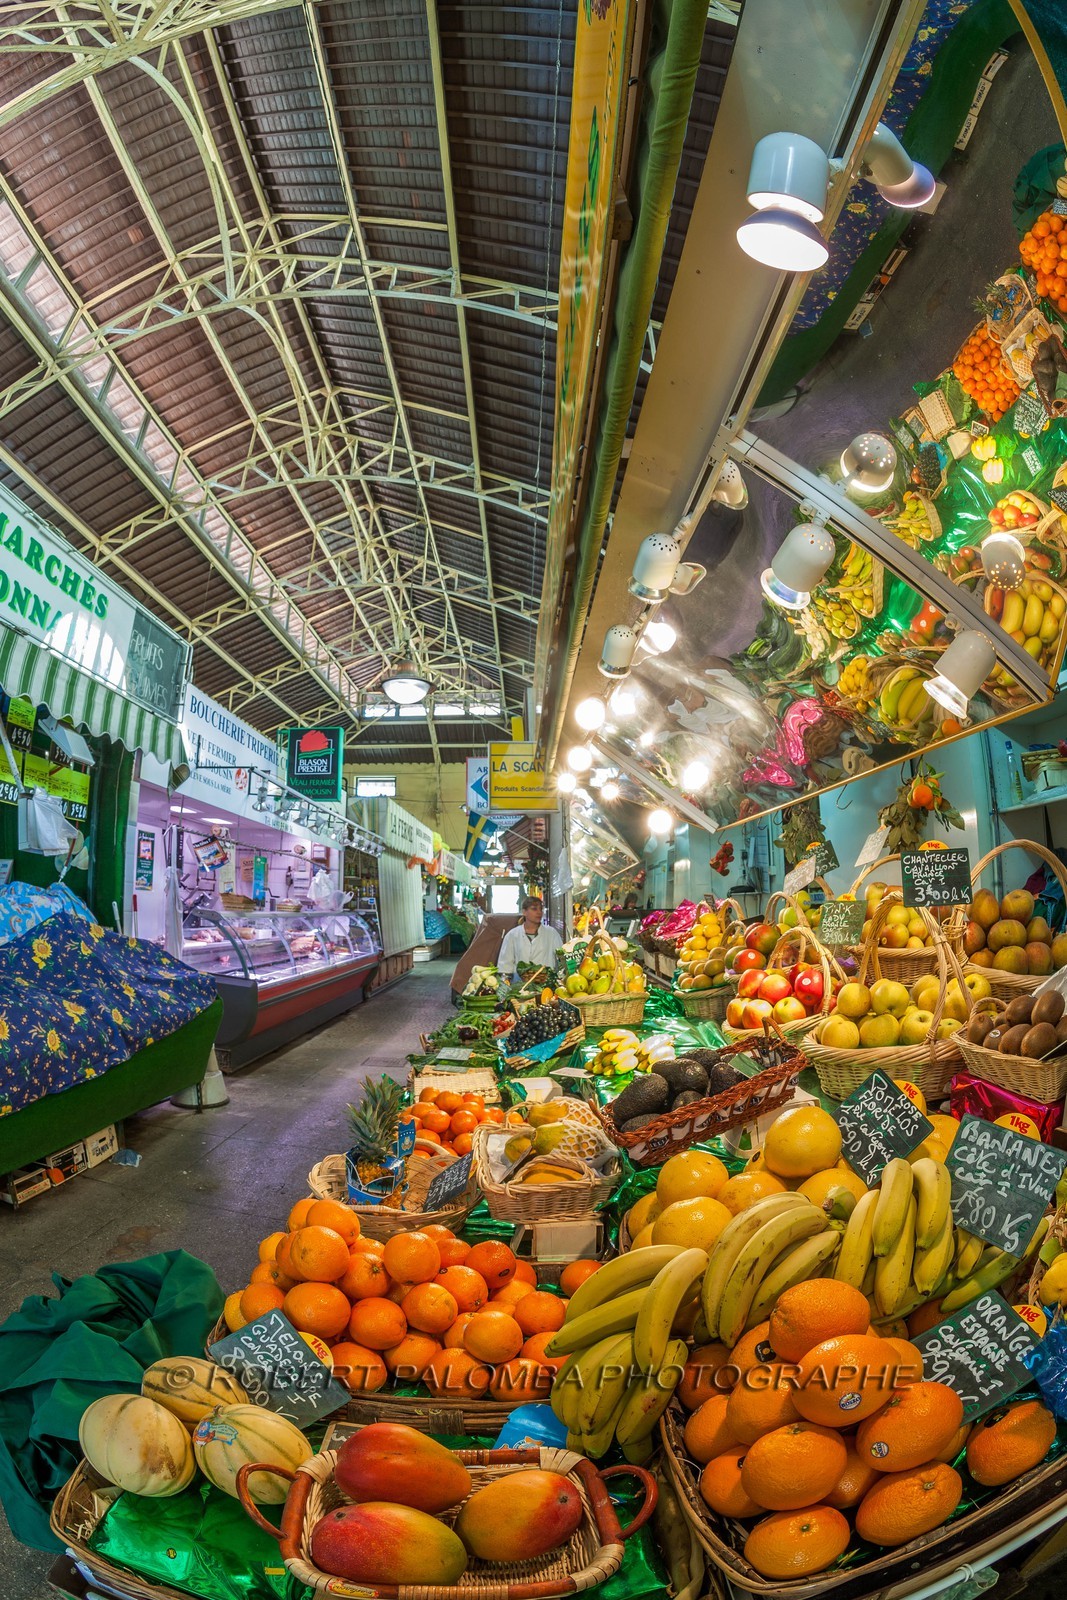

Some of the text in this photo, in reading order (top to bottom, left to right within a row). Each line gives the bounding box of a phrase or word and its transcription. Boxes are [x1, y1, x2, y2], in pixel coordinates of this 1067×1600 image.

[130, 629, 164, 671] FRUITS
[189, 695, 280, 767] BOUCHERIE TRIPERIE
[207, 741, 237, 767] FERMIER
[299, 758, 328, 766] BLASON
[492, 761, 508, 772] LA
[297, 765, 329, 773] PRESTIGE
[903, 850, 967, 865] CHANTECLER
[903, 1083, 918, 1099] 1kg
[859, 1090, 896, 1136] FLORIDE
[871, 1073, 918, 1136] POMELOS
[897, 1094, 923, 1121] ROSE
[1010, 1115, 1031, 1134] 1kg
[961, 1120, 1067, 1181] BANANES
[999, 1213, 1033, 1253] Kg
[1020, 1306, 1040, 1323] 1kg
[960, 1314, 1010, 1372] ESPAGNE
[976, 1296, 1042, 1369] ORANGES
[310, 1338, 329, 1360] 1kg
